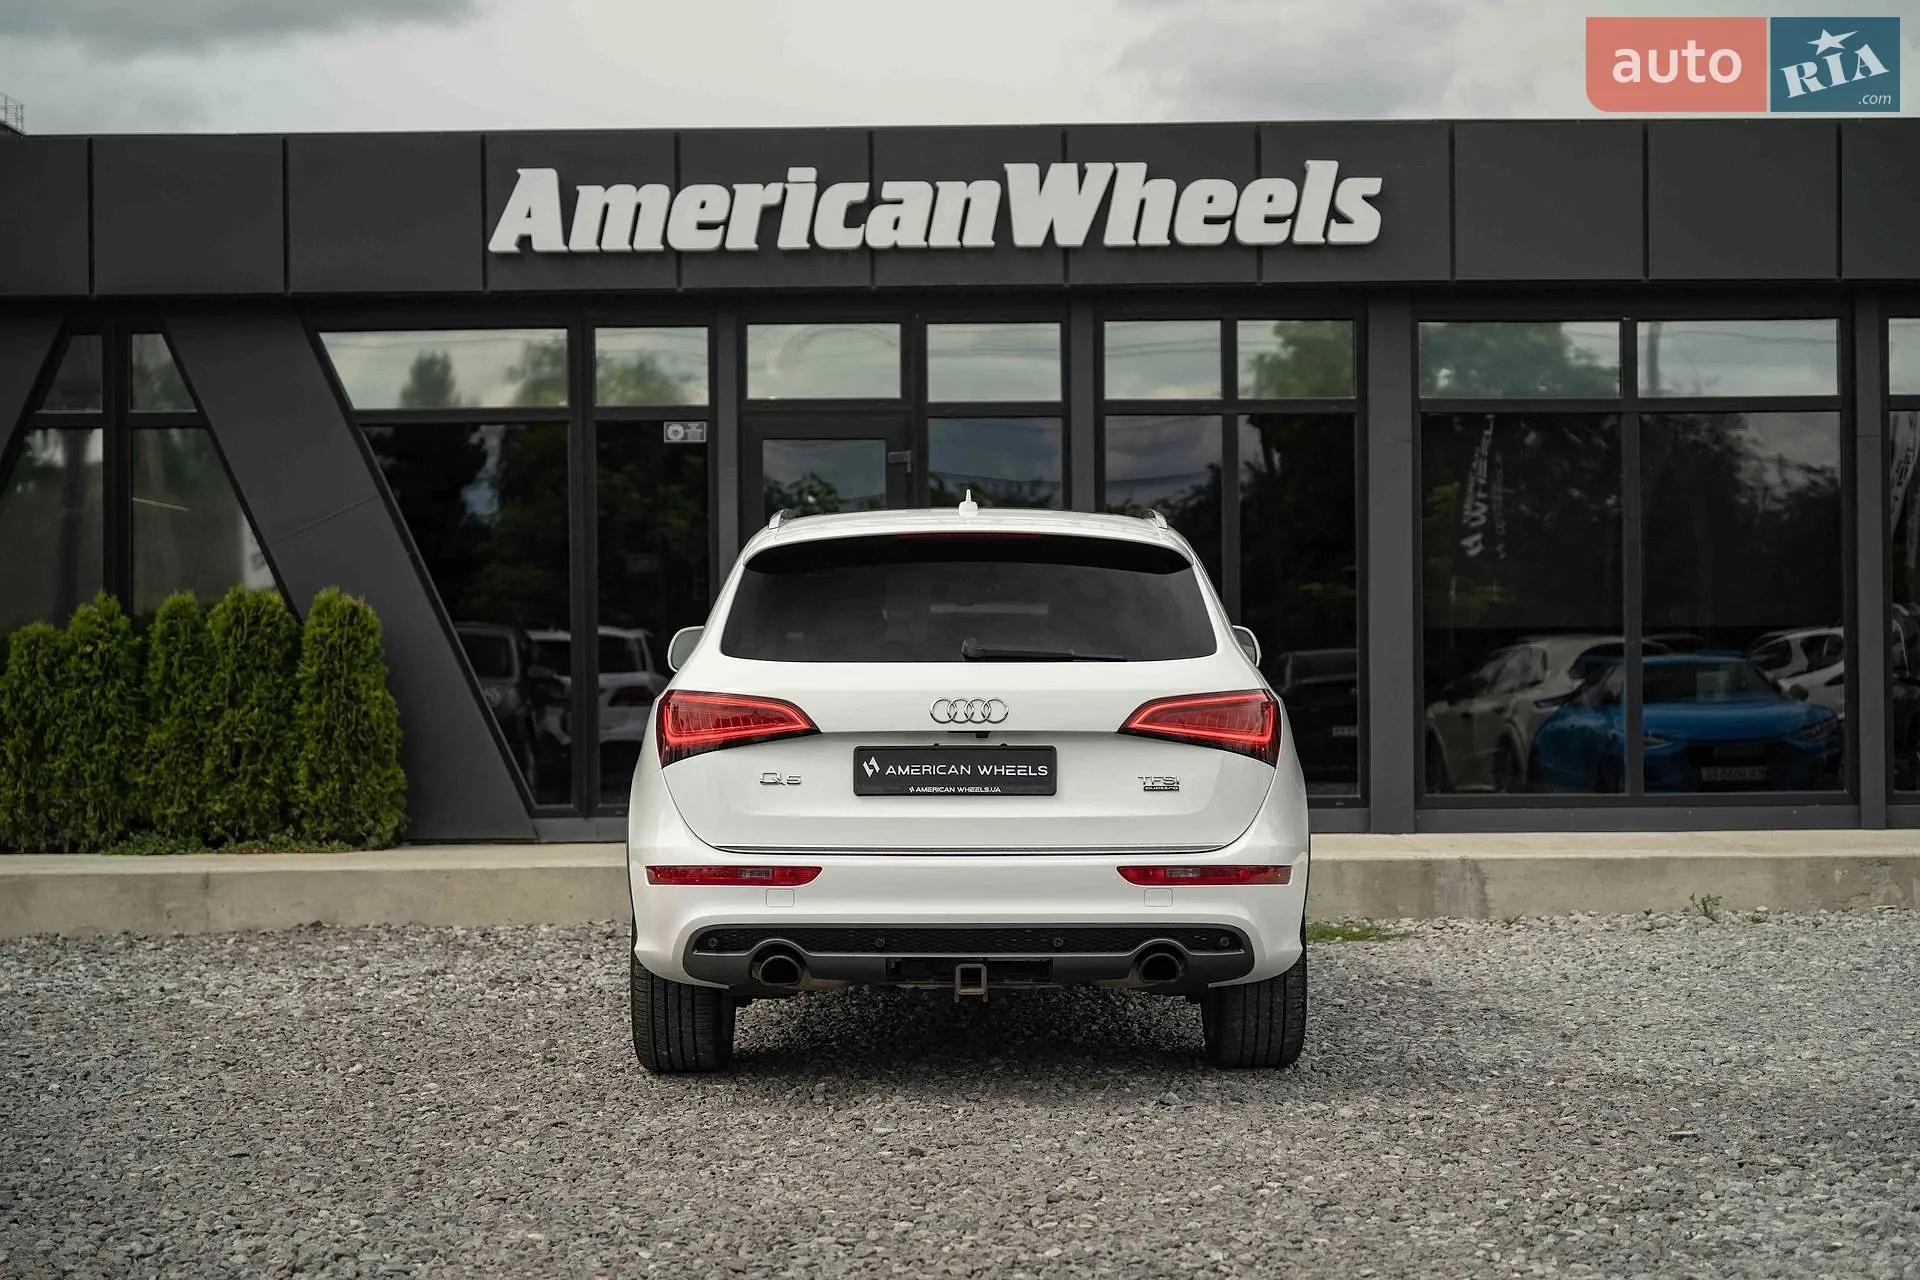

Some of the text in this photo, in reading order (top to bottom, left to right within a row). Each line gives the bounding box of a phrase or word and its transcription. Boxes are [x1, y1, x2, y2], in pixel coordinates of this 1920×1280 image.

[488, 159, 1383, 255] AmericanWheels
[885, 764, 1049, 776] AMERICAN WHEELS
[759, 771, 801, 785] Q5
